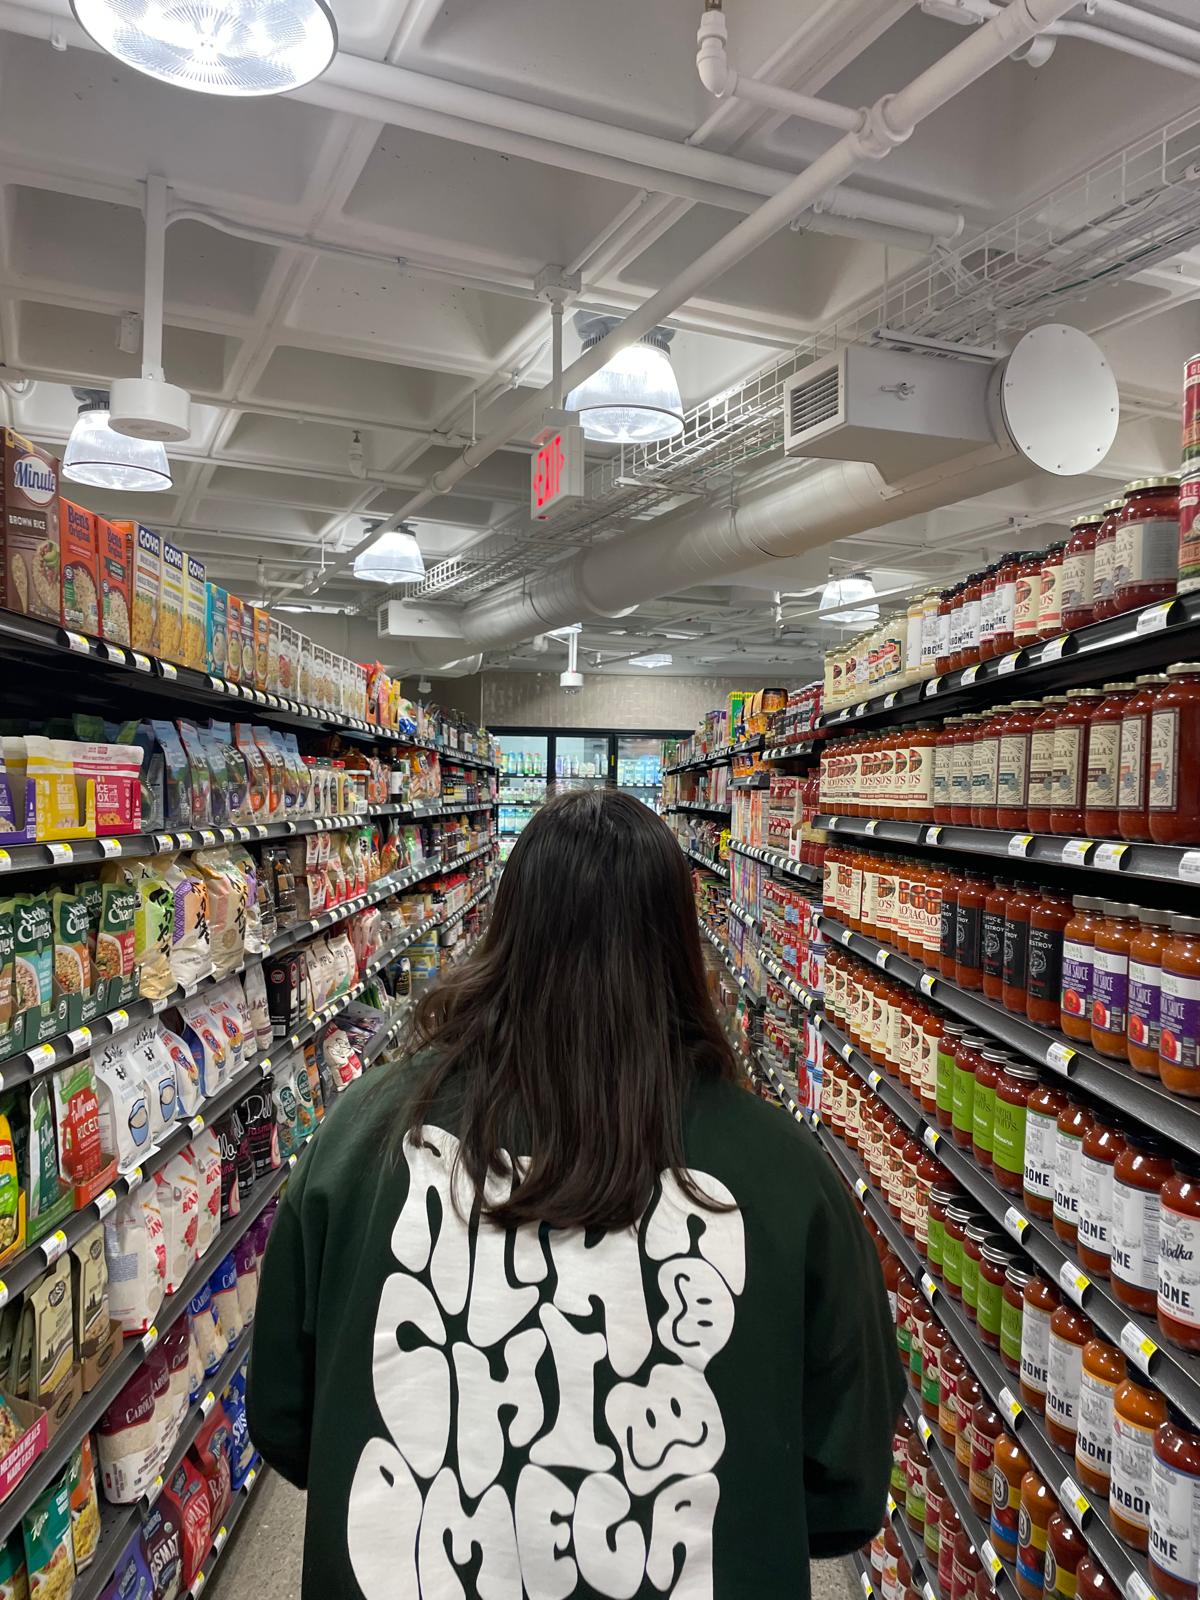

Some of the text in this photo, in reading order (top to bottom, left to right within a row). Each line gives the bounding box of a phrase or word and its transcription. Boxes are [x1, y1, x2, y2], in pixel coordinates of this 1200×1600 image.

[14, 461, 57, 493] Minute
[8, 514, 47, 531] BROWN RICE
[139, 529, 161, 554] GOYA
[164, 543, 183, 570] GOYA
[188, 559, 206, 581] GOYA
[1072, 964, 1089, 982] SAUCE
[1099, 974, 1114, 992] SAUCE
[1135, 986, 1152, 1005] SAUCE
[1168, 1000, 1186, 1020] SAUCE
[218, 1134, 238, 1161] lla
